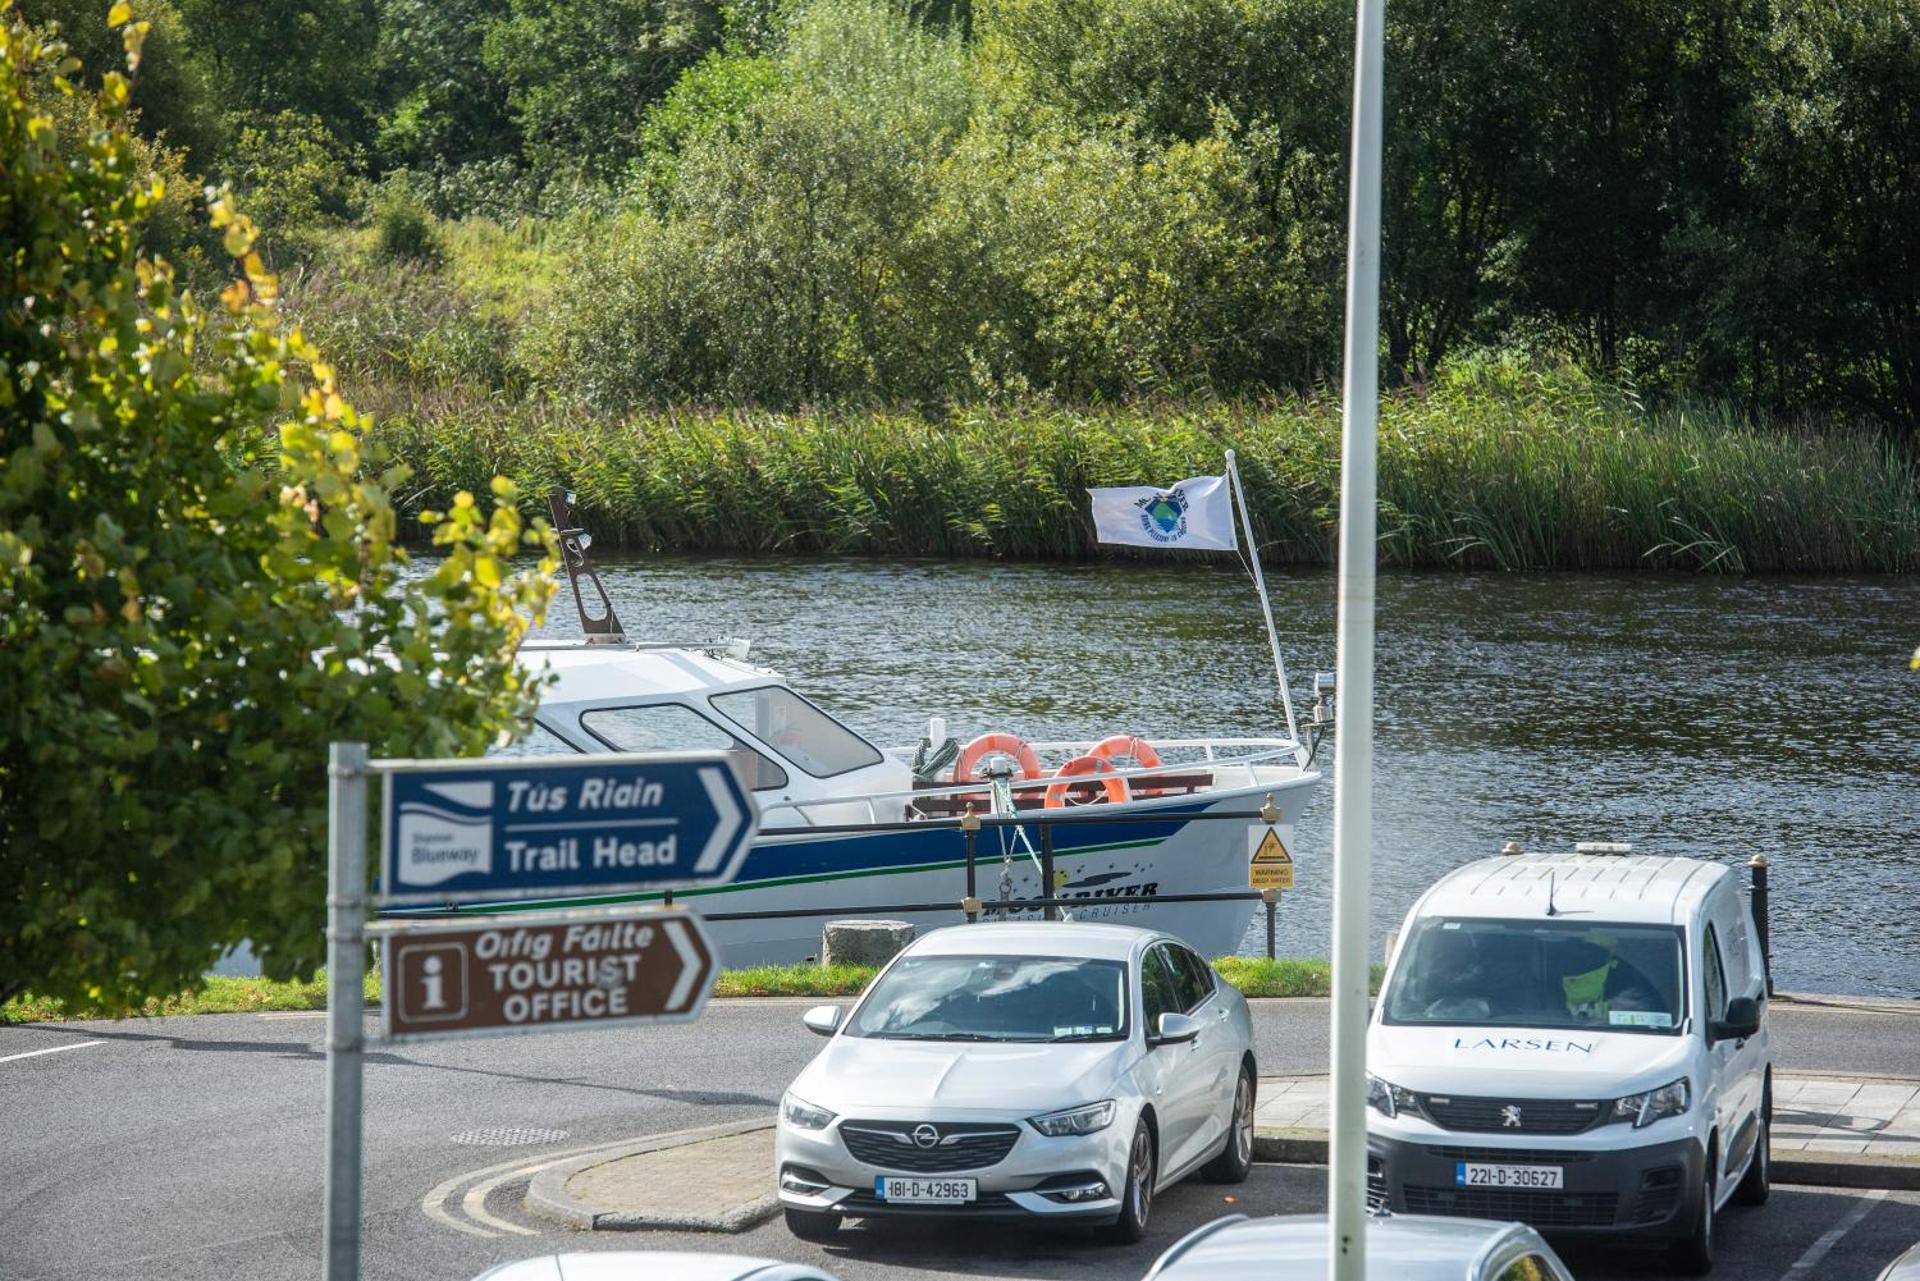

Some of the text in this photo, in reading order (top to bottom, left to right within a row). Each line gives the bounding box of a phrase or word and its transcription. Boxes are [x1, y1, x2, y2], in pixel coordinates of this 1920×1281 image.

[507, 777, 664, 813] Tús Riain
[412, 848, 478, 864] Blueway
[505, 835, 676, 872] Trail Head
[1079, 903, 1151, 920] CRUISER
[475, 922, 655, 960] Oifig Fáilte
[489, 955, 641, 991] TOURIST
[503, 987, 629, 1022] OFFICE
[1453, 1037, 1594, 1055] LARSEN
[889, 1181, 969, 1198] 181-D-42963
[1470, 1168, 1557, 1186] 221-D-30627
